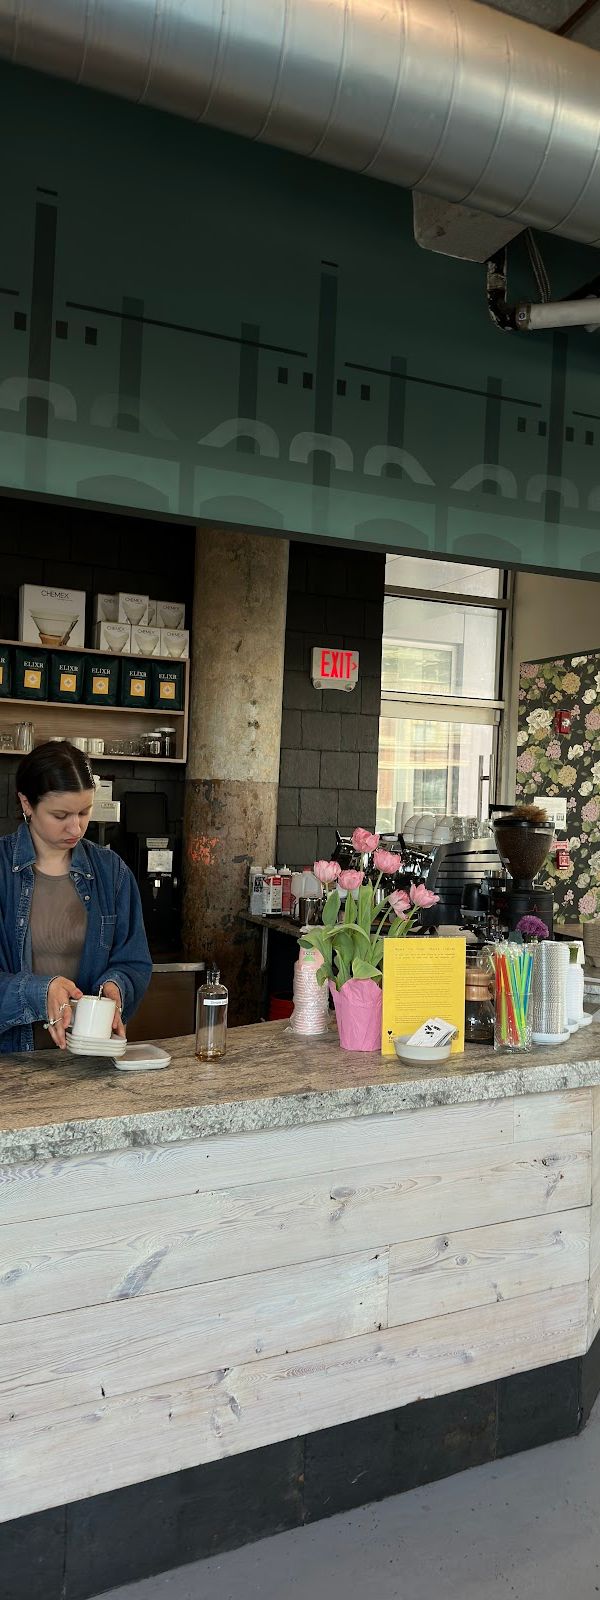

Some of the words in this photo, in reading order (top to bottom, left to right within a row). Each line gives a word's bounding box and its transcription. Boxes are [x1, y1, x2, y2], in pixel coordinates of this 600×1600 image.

[41, 589, 69, 599] CHEMEX
[59, 664, 79, 672] ELIXR
[321, 650, 353, 679] EXIT
[91, 667, 111, 675] ELIXR
[129, 670, 147, 678] ELIXR
